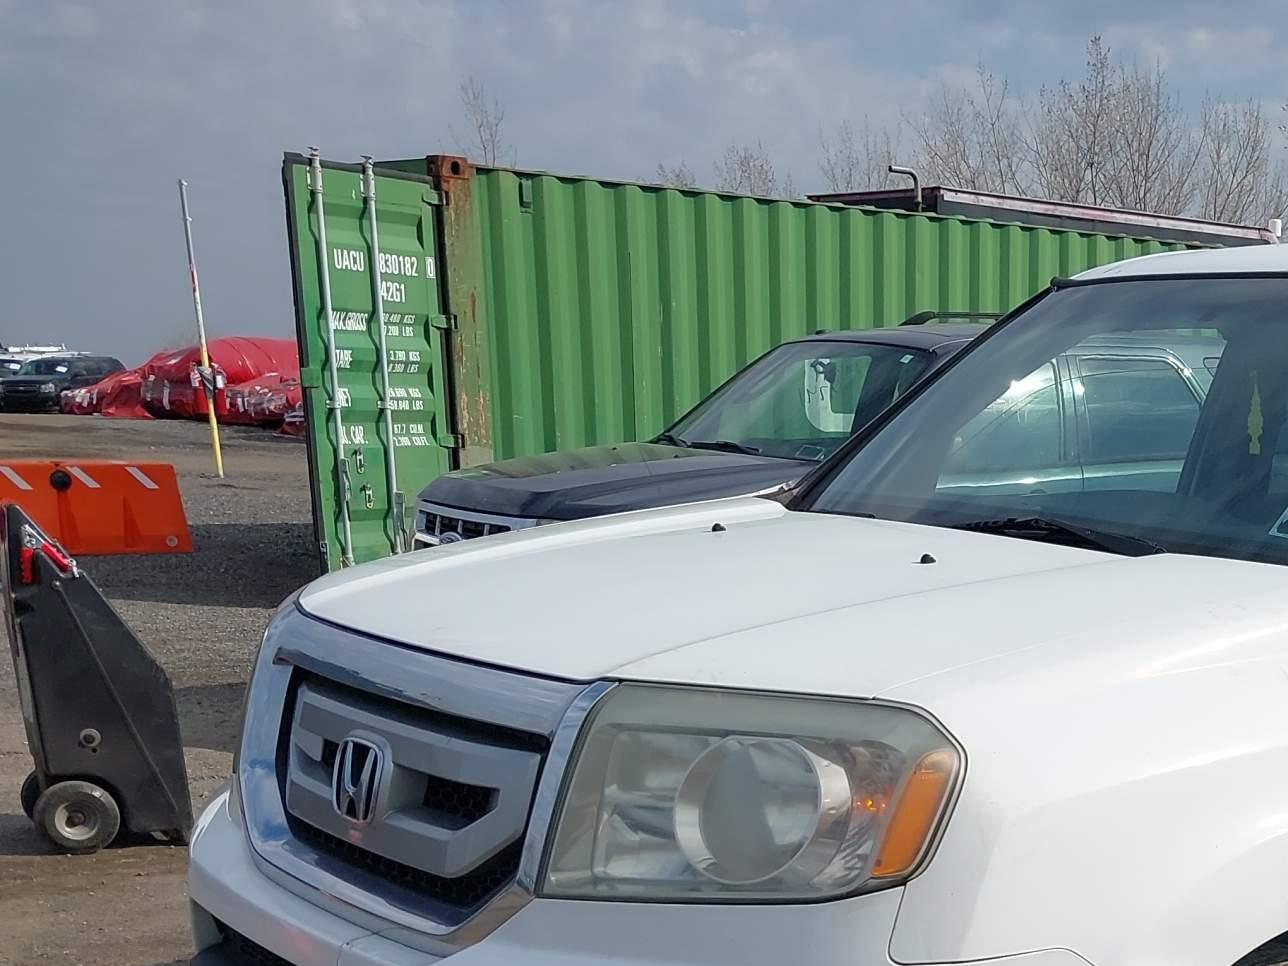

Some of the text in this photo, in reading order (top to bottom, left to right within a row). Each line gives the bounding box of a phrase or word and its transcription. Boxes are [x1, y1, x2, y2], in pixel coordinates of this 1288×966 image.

[333, 248, 436, 278] UACU 830182 0
[381, 281, 406, 303] 42G1
[402, 314, 416, 324] KGS
[402, 326, 414, 337] LBS
[335, 349, 353, 369] TARE
[408, 350, 421, 362] KGS
[406, 364, 420, 373] LBS
[408, 387, 422, 398] KGS
[412, 400, 424, 411] LBS
